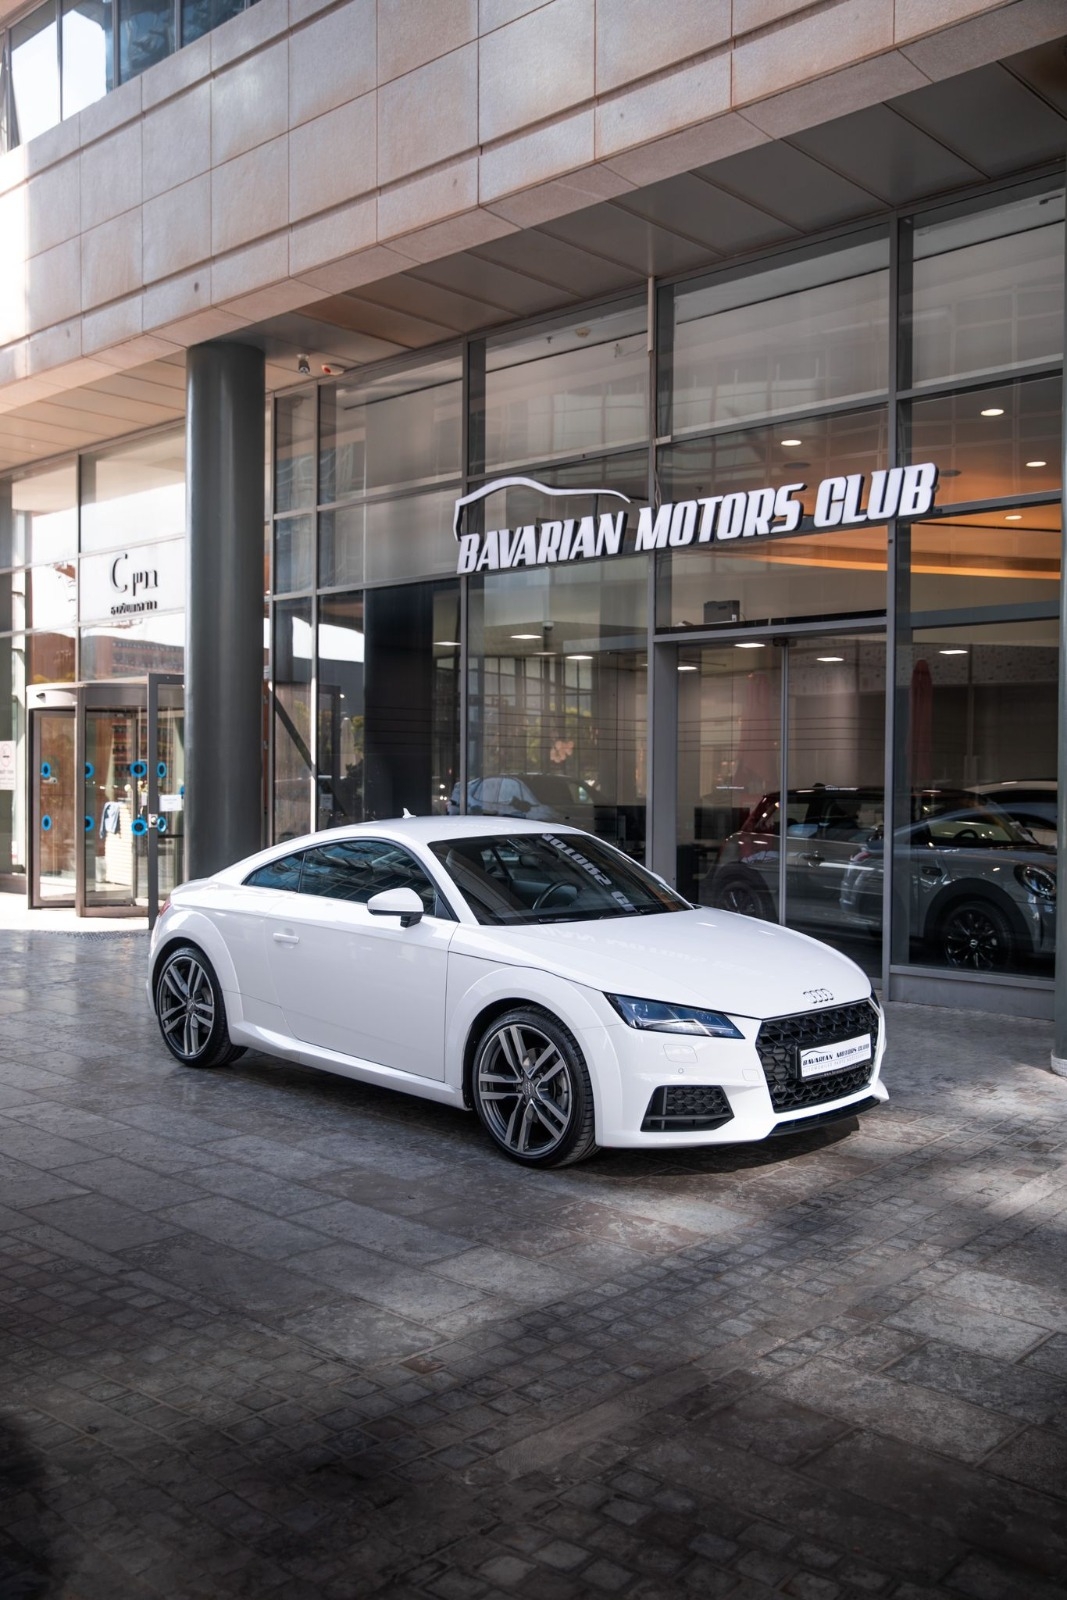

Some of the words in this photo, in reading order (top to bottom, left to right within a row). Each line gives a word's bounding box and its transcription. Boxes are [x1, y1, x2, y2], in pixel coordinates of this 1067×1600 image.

[456, 511, 627, 575] BAVARIAN
[635, 483, 807, 552] MOTORS
[814, 462, 938, 528] CLUB
